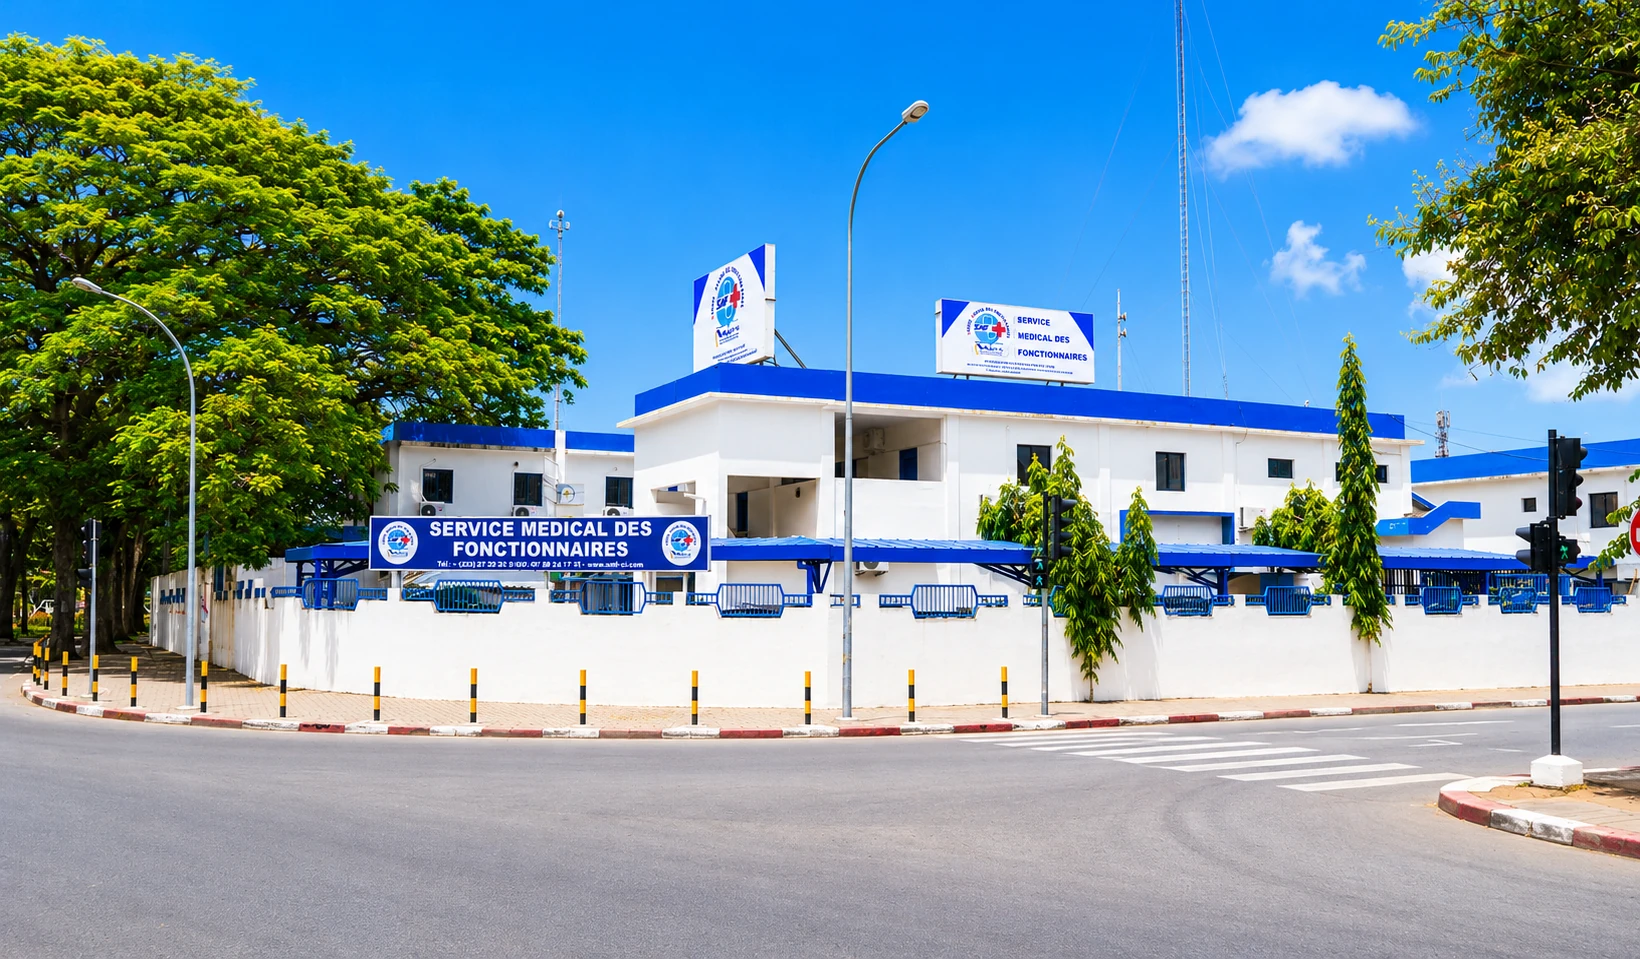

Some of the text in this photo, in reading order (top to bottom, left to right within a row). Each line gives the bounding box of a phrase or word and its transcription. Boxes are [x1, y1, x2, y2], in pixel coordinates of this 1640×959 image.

[1017, 316, 1051, 326] SERVICE
[1017, 332, 1071, 344] MEDICAL DES
[1017, 349, 1088, 361] FONCTIONNAIRES
[430, 521, 514, 537] SERVICE
[521, 521, 609, 537] MEDICAL
[614, 521, 652, 537] DES
[454, 540, 629, 557] FONCTIONNAIRES
